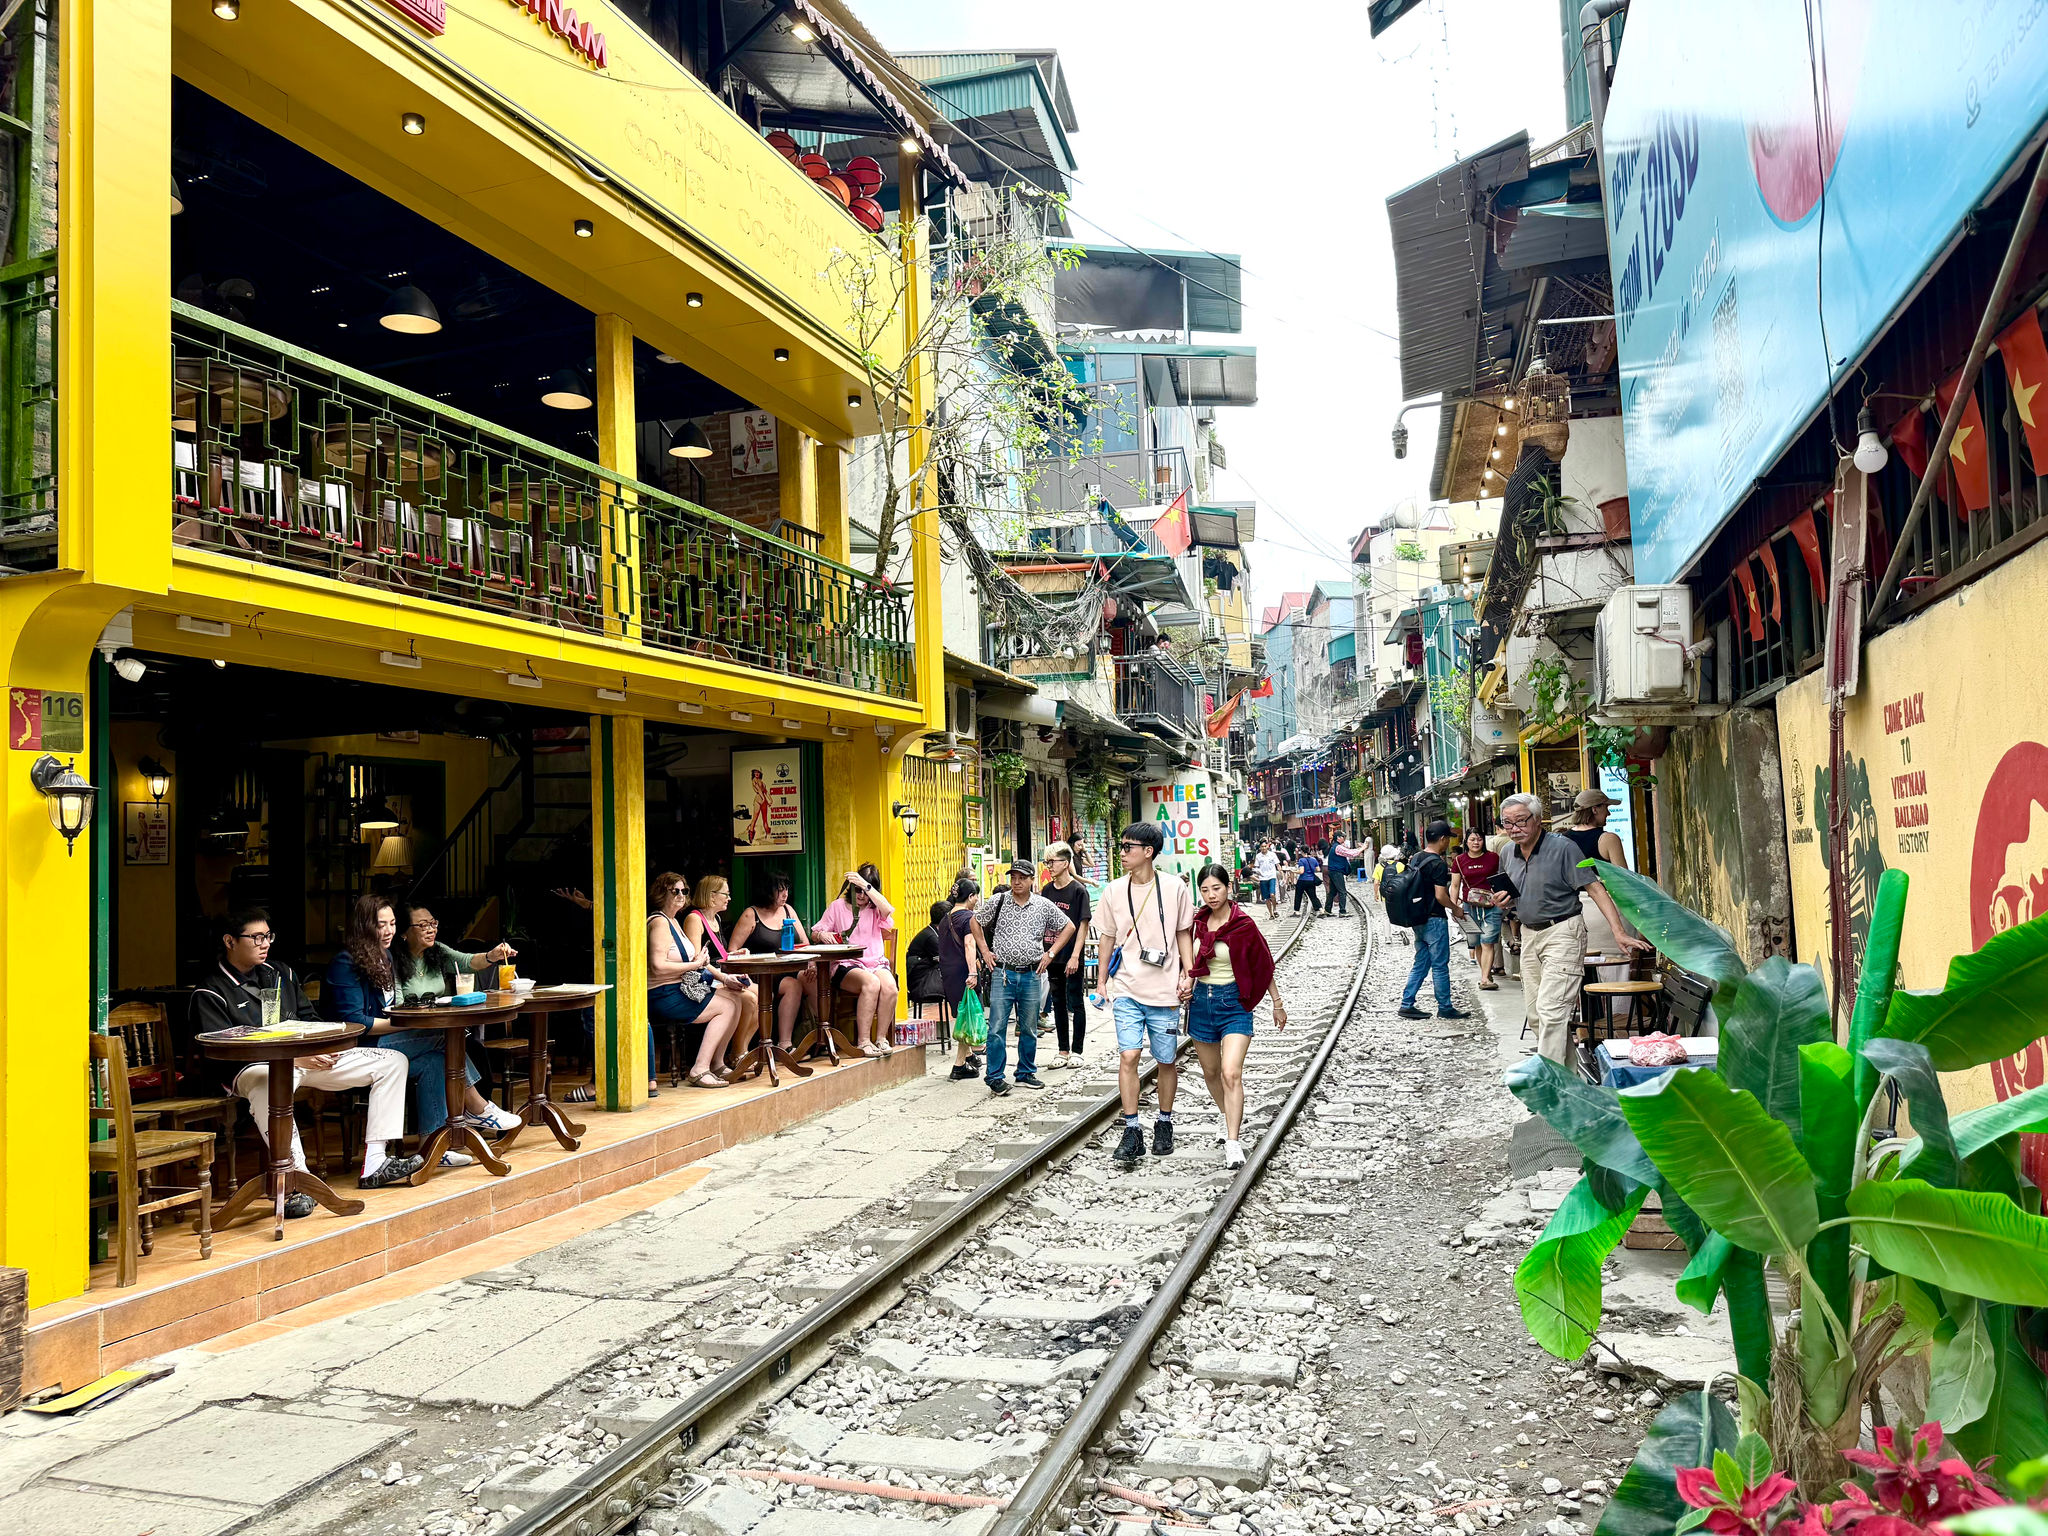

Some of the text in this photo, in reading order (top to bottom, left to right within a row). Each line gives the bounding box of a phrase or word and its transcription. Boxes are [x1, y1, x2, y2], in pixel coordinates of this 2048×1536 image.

[1620, 232, 1643, 344] FROM
[1680, 294, 1691, 341] in
[1691, 215, 1723, 318] Hanoi
[42, 696, 82, 718] 116
[1883, 691, 1926, 735] COME BACK
[1900, 736, 1911, 766] TO
[1147, 783, 1207, 803] THERE
[1891, 769, 1928, 800] VIETNAM
[1156, 801, 1200, 821] AE
[1894, 802, 1929, 829] RAILROAD
[1161, 820, 1194, 838] NO
[1162, 838, 1210, 856] ULES
[1898, 830, 1930, 854] HISTORY
[682, 1427, 694, 1449] 53
